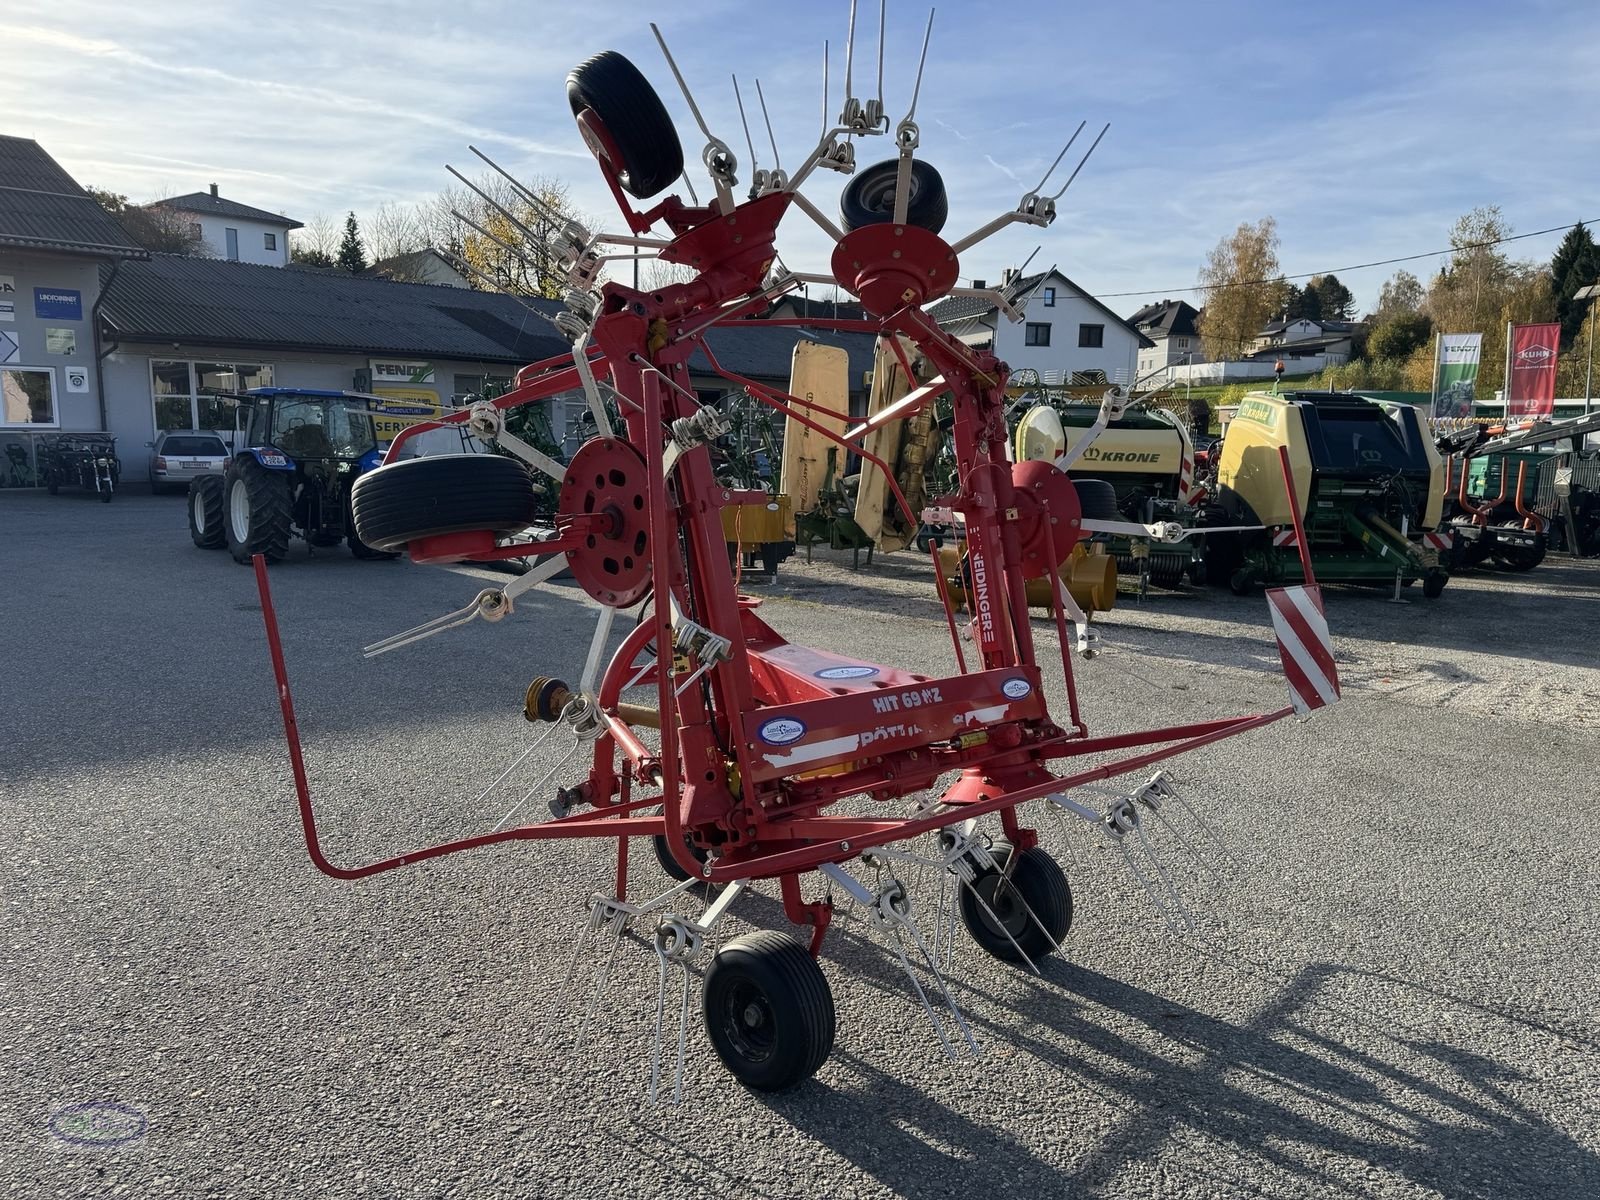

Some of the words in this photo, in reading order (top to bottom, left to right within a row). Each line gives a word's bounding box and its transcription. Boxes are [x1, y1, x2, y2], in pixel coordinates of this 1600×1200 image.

[1445, 345, 1479, 353] FENDT
[1521, 350, 1550, 358] KUHN
[376, 364, 428, 376] FENDT
[1246, 409, 1270, 420] KRONE
[1101, 451, 1161, 463] KRONE
[872, 694, 900, 714] HIT
[901, 691, 922, 708] 69
